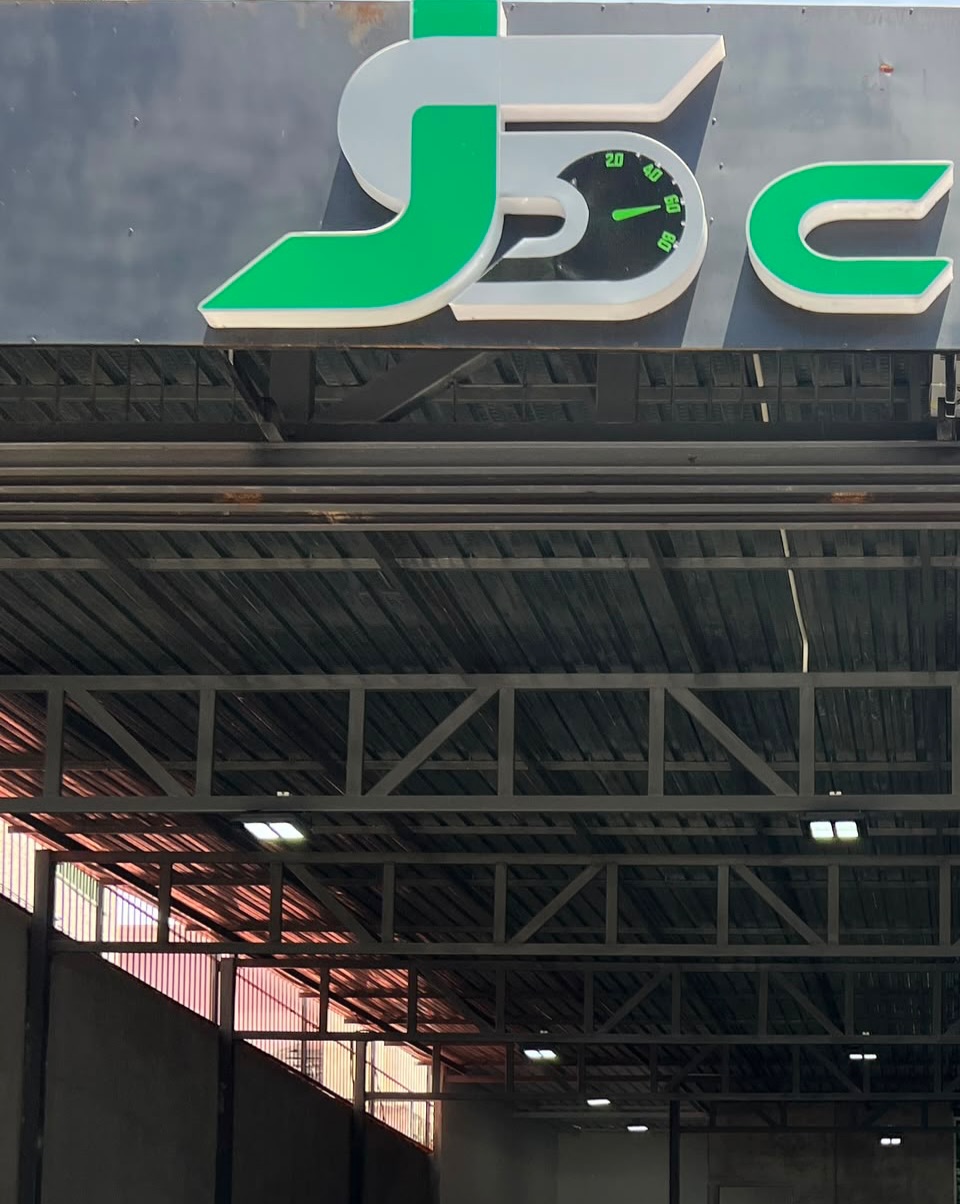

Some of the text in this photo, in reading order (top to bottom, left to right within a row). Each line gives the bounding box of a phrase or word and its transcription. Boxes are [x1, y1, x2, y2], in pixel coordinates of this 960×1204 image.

[605, 152, 681, 253] 20 40 60 80
